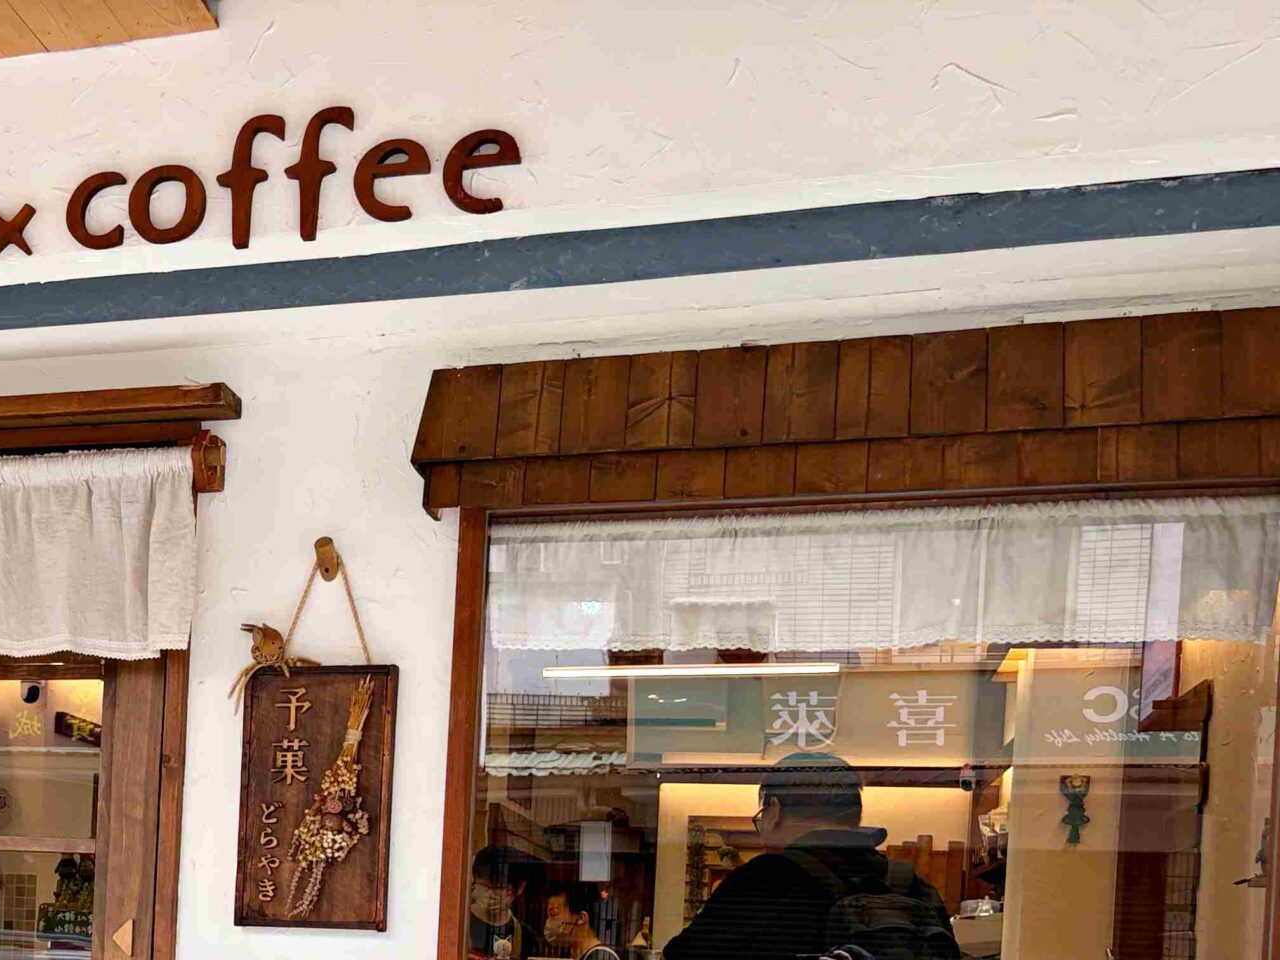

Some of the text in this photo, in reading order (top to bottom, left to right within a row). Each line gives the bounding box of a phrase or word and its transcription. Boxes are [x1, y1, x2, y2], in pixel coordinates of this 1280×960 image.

[66, 106, 521, 250] coffee
[271, 687, 312, 785] 予菓
[258, 802, 283, 901] どらやき
